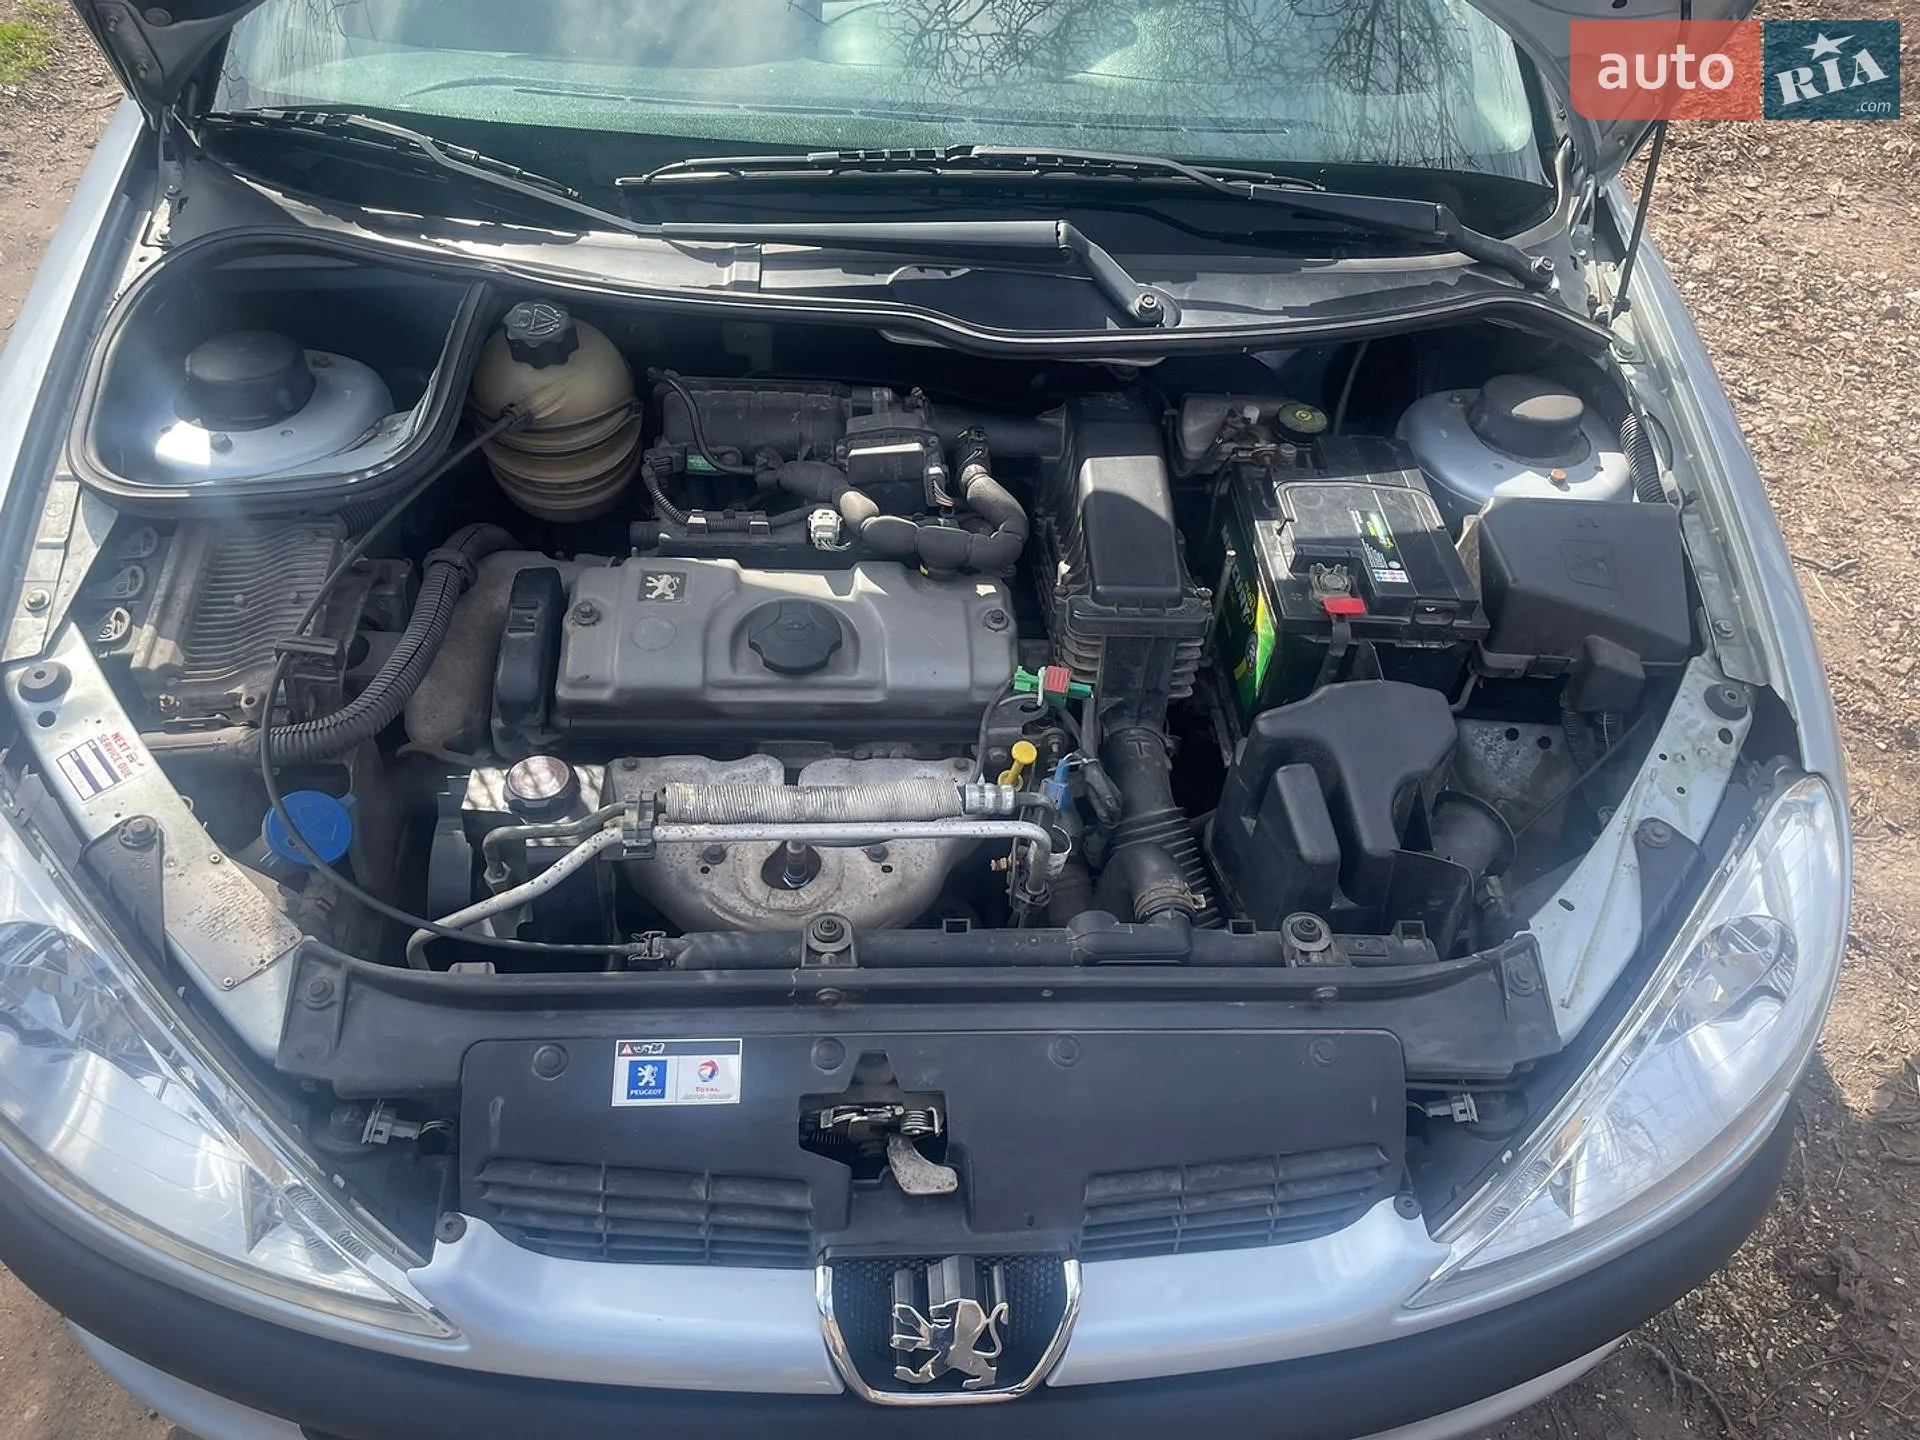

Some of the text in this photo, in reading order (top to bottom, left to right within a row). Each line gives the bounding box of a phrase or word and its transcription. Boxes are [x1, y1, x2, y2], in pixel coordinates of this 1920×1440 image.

[111, 731, 131, 752] NEXT
[98, 733, 135, 779] SERVICE DUE
[629, 1088, 663, 1097] PEUGEOT
